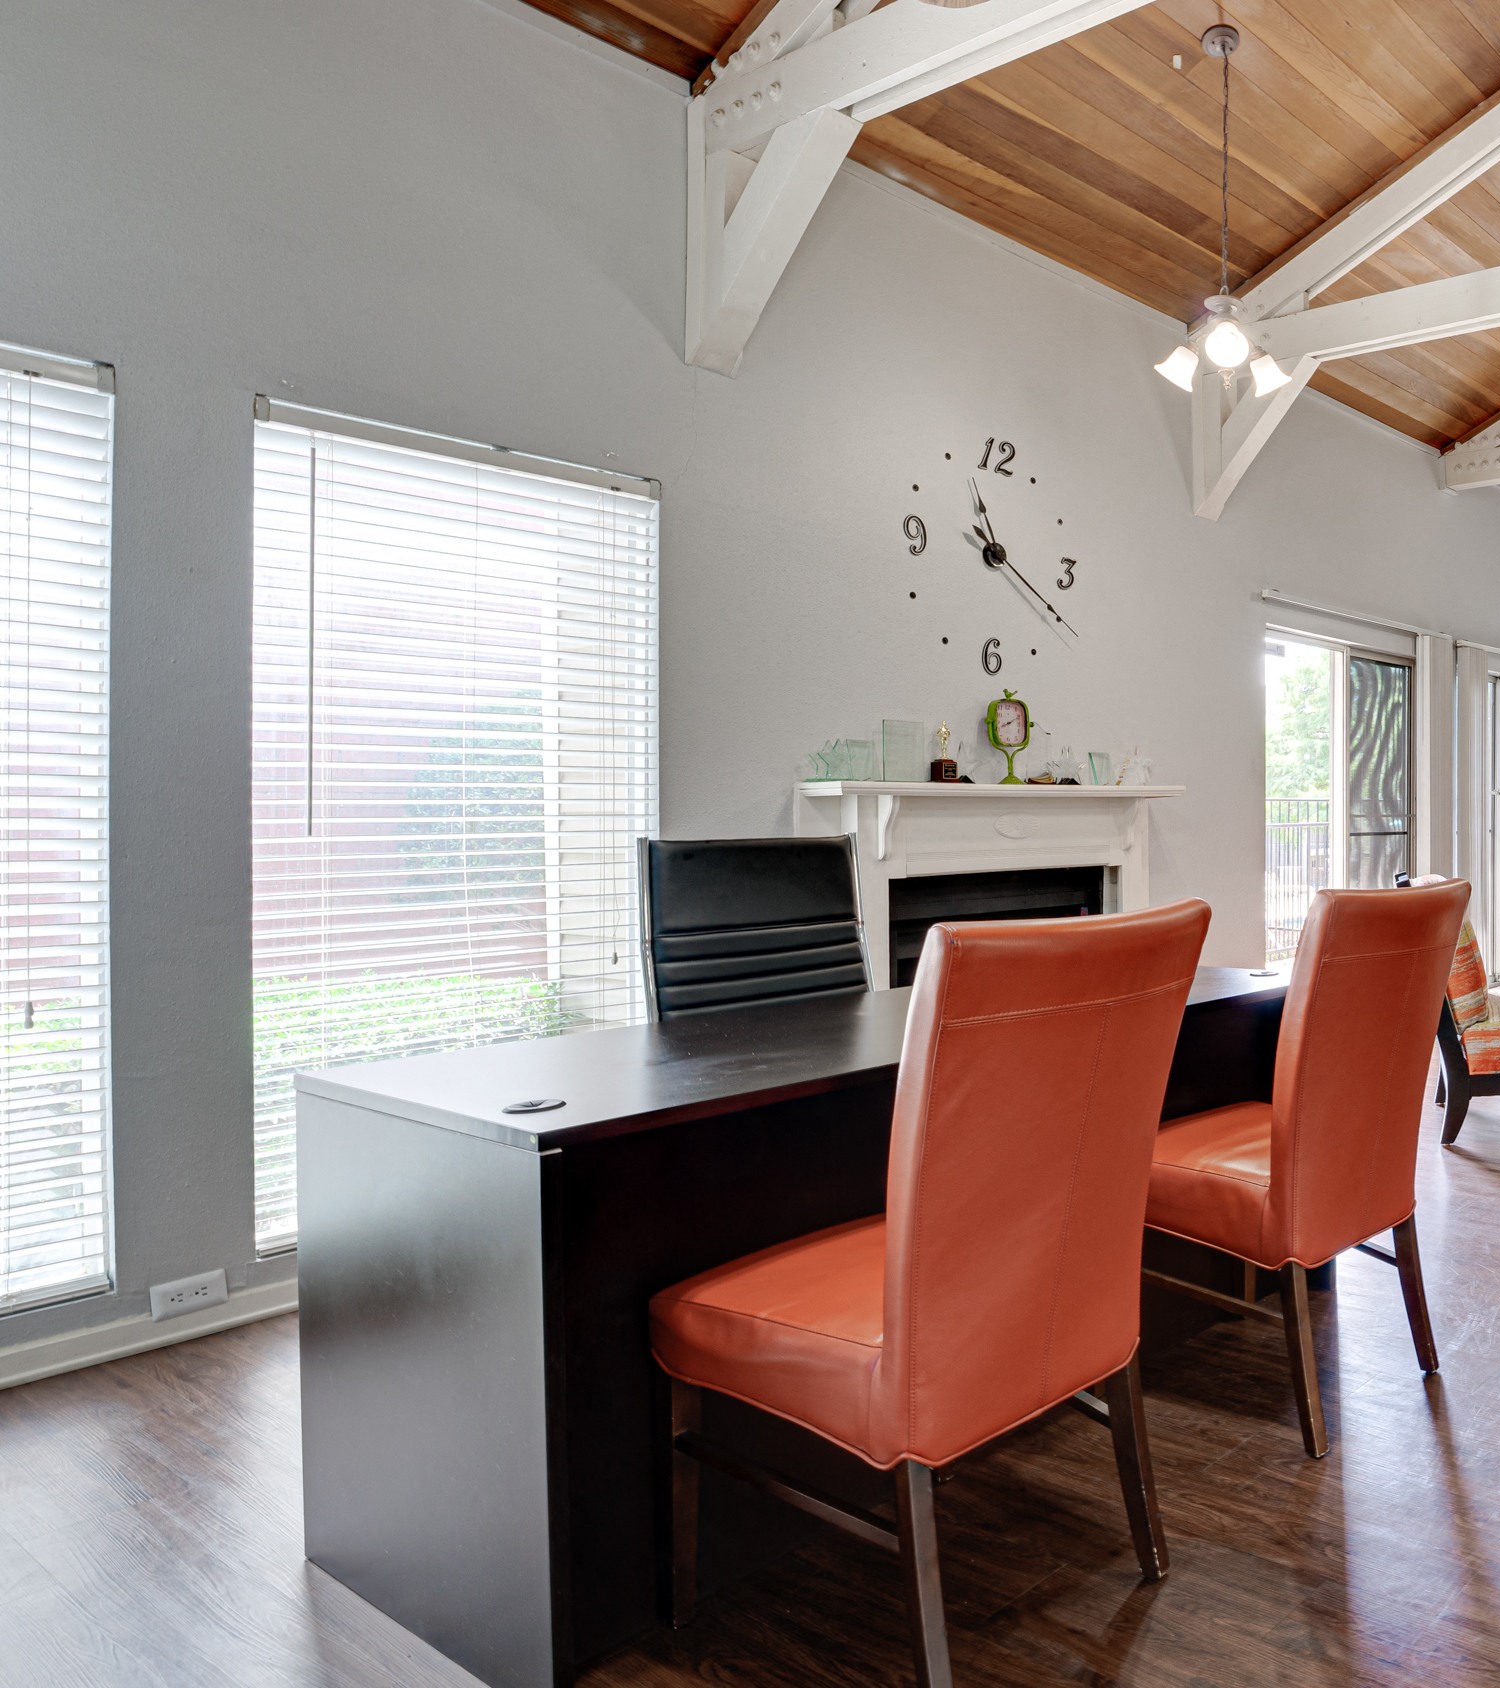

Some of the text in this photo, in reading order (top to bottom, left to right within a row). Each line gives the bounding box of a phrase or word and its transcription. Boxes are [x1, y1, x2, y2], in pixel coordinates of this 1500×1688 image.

[977, 437, 1016, 477] 12
[902, 514, 928, 556] 9
[1056, 557, 1077, 590] 3
[981, 637, 1003, 675] 6
